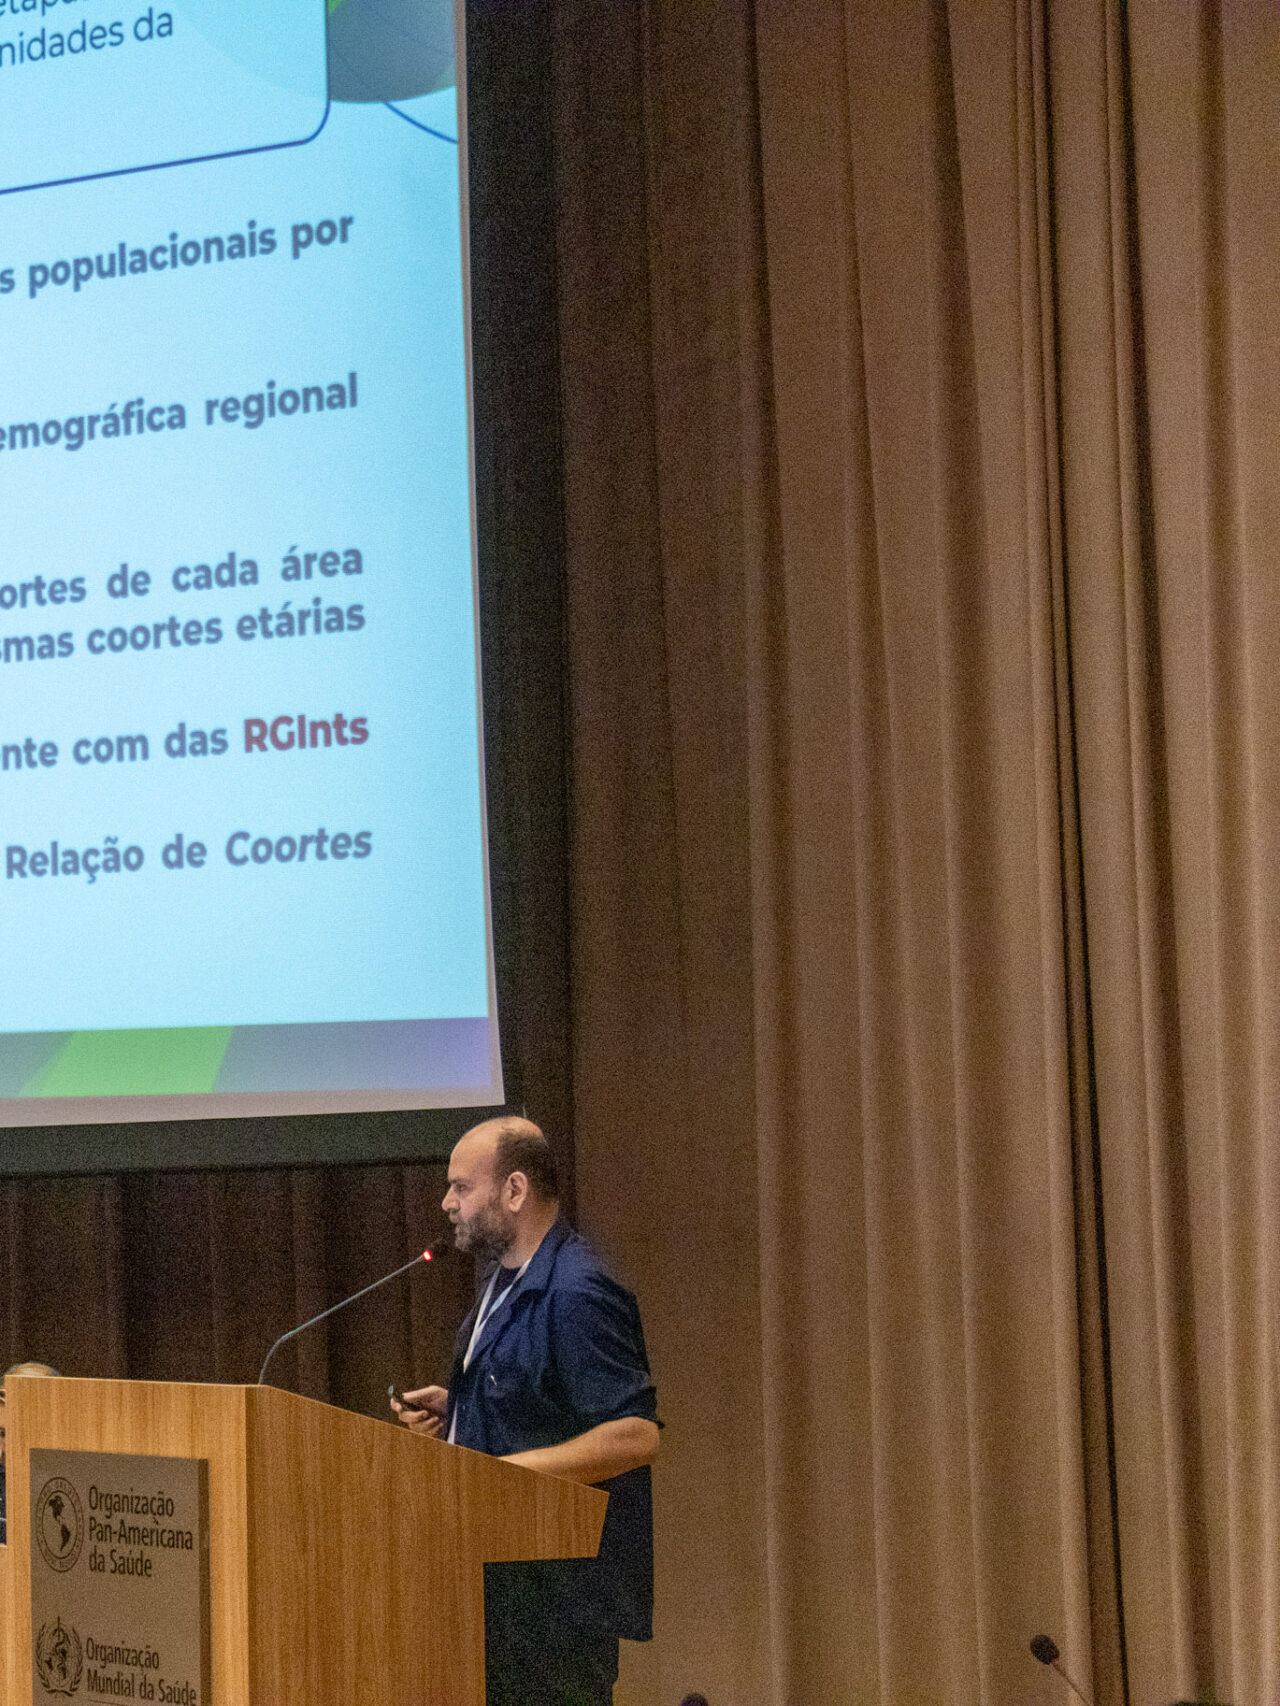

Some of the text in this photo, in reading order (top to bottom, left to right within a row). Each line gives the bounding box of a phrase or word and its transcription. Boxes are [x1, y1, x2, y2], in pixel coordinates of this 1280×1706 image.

[133, 6, 173, 42] da
[28, 219, 277, 299] populacionais
[291, 215, 354, 260] por
[205, 371, 358, 430] regional
[106, 562, 152, 599] de
[171, 551, 259, 593] cada
[280, 545, 363, 582] área
[86, 615, 223, 655] coortes
[236, 596, 366, 641] etárias
[72, 733, 150, 765] com
[164, 721, 229, 759] das
[243, 712, 370, 753] RGInts
[5, 836, 145, 885] Relação
[161, 833, 207, 870] de
[225, 827, 372, 867] Coortes
[88, 1485, 174, 1520] Organização
[88, 1516, 193, 1550] Pan-Americana
[89, 1545, 152, 1577] da Saúde
[86, 1637, 160, 1671] Organização
[86, 1669, 197, 1706] Mundial da Saúde
